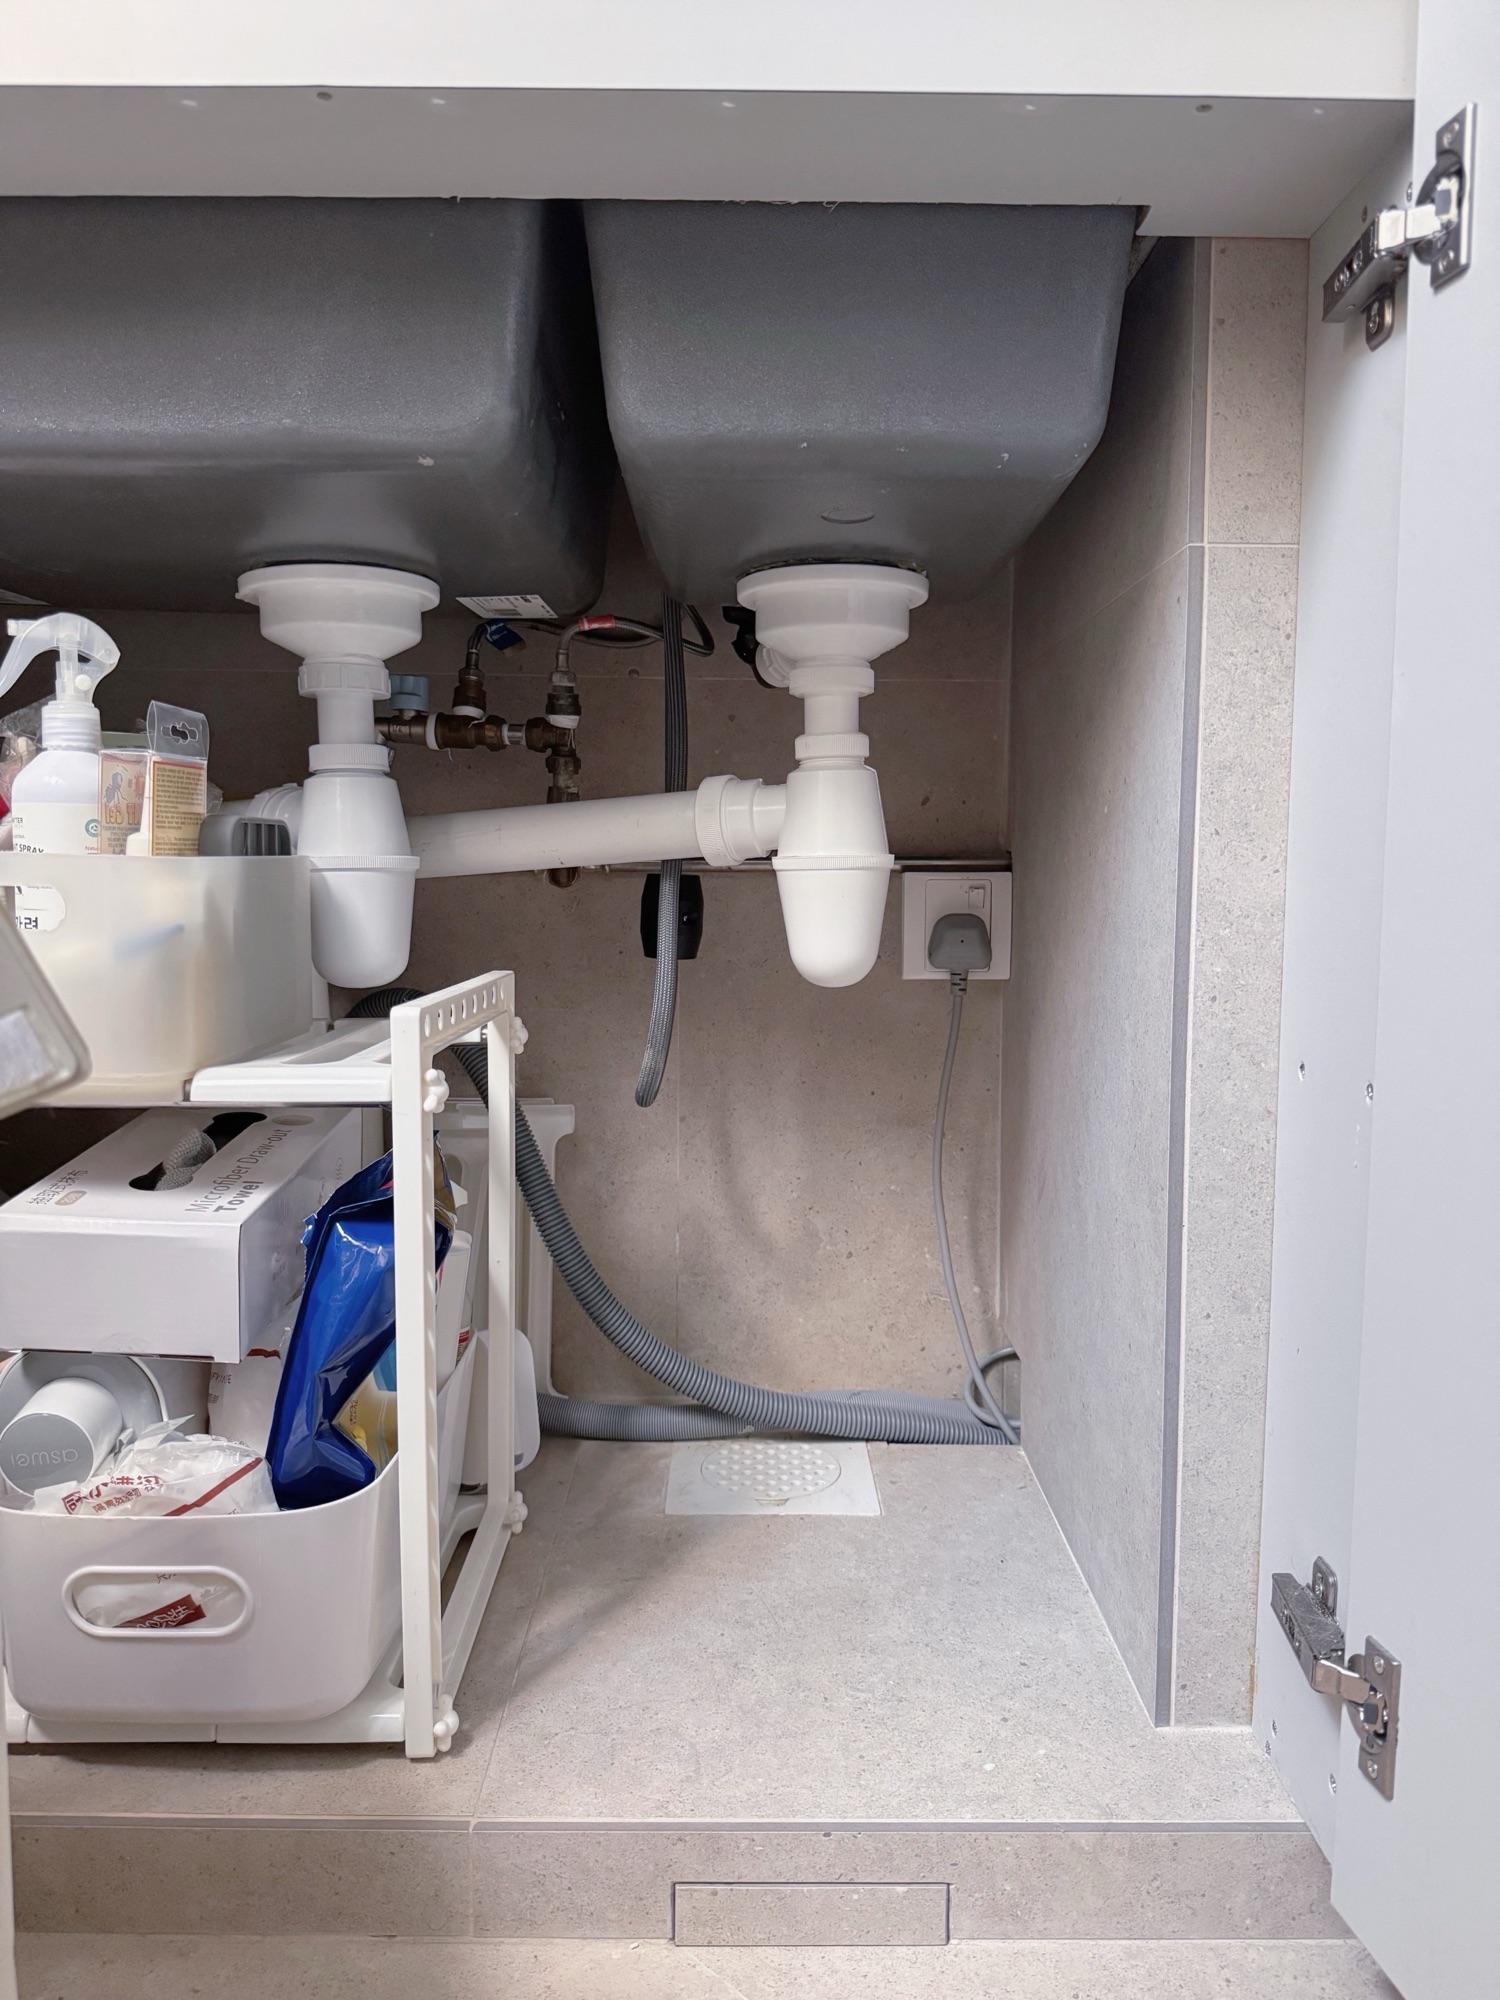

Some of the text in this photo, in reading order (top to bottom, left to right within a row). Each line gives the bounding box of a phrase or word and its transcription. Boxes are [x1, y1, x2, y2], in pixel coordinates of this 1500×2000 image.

[184, 1129, 292, 1212] Microfiber Draw-out
[213, 1181, 264, 1212] Towel
